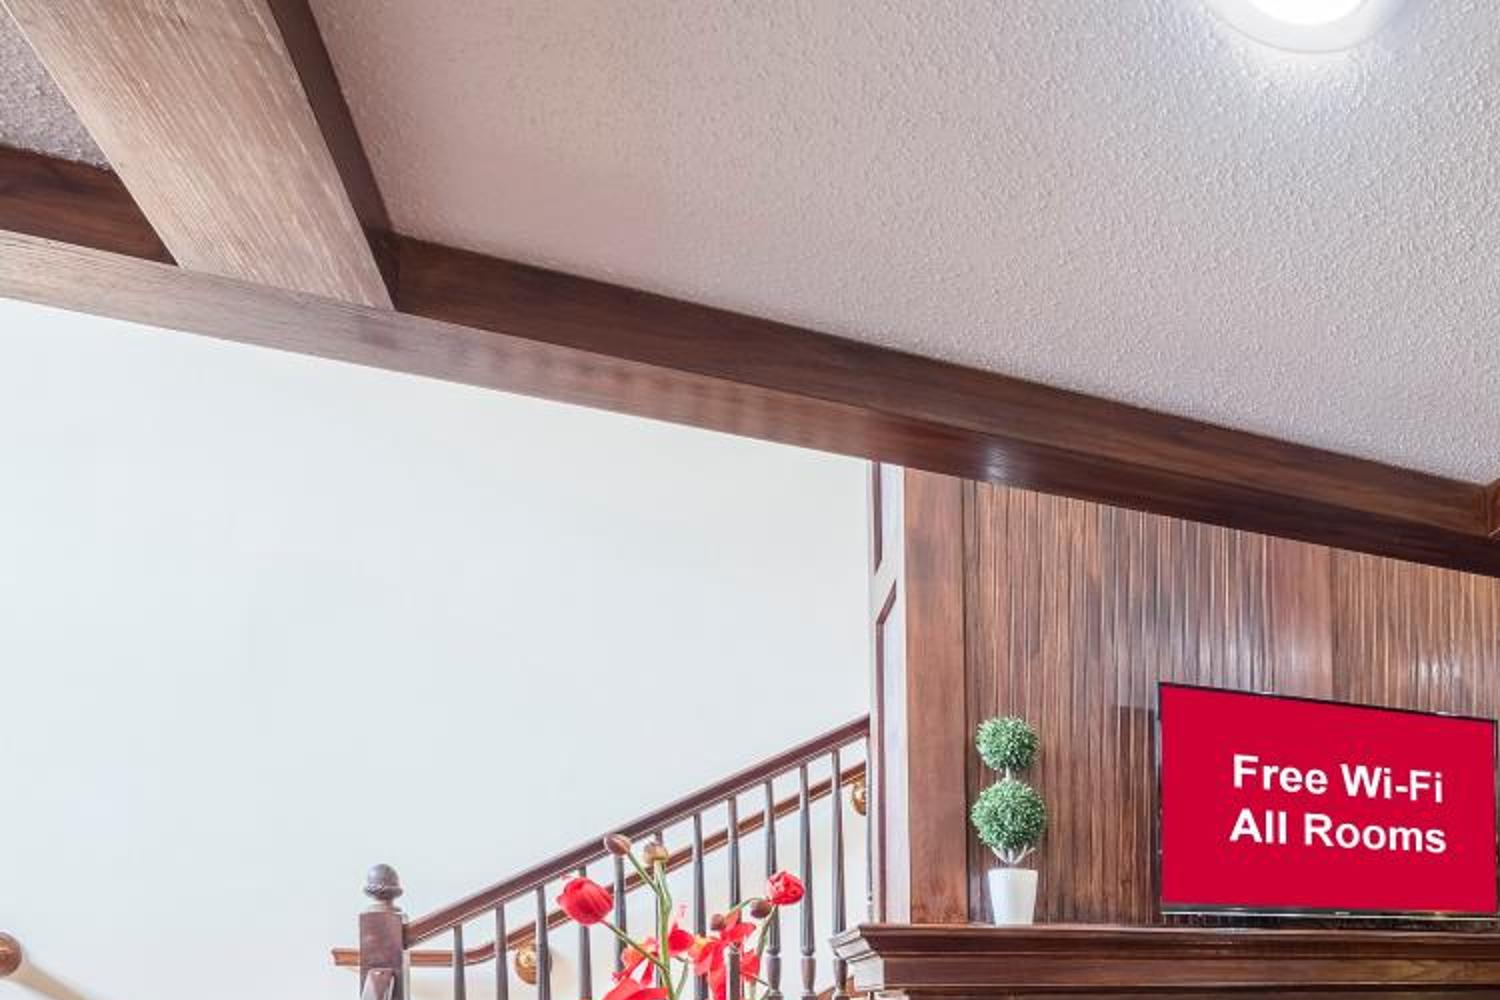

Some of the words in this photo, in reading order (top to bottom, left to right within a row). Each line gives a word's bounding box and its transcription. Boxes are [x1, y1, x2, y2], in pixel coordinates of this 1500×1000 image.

[1233, 753, 1329, 795] Free
[1340, 763, 1444, 803] Wi-Fi
[1229, 808, 1288, 845] All
[1304, 812, 1447, 854] Rooms
